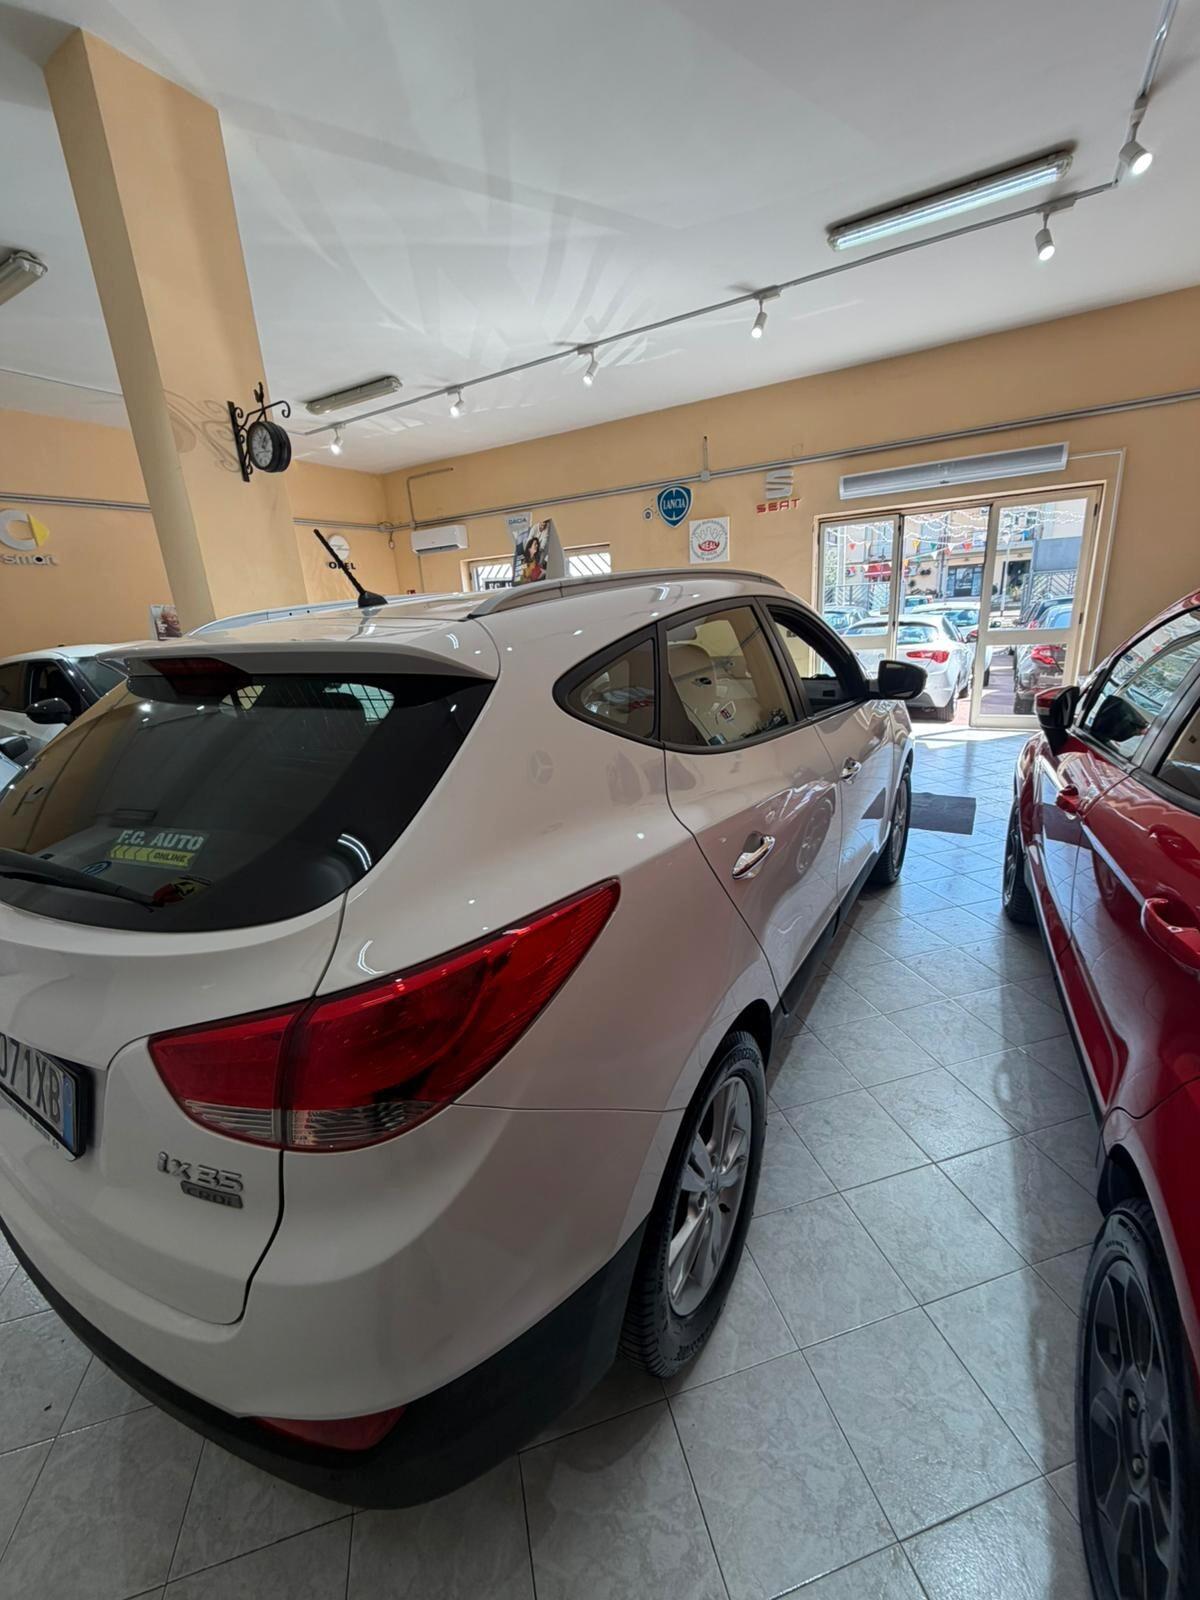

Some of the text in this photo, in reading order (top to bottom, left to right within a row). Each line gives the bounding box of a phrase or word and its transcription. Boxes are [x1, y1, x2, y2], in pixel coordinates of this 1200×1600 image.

[663, 498, 686, 510] LANCIA
[756, 498, 800, 513] SEAT
[328, 561, 356, 570] OEL
[117, 829, 205, 850] F.C. AUTO
[153, 851, 188, 863] ONLINE
